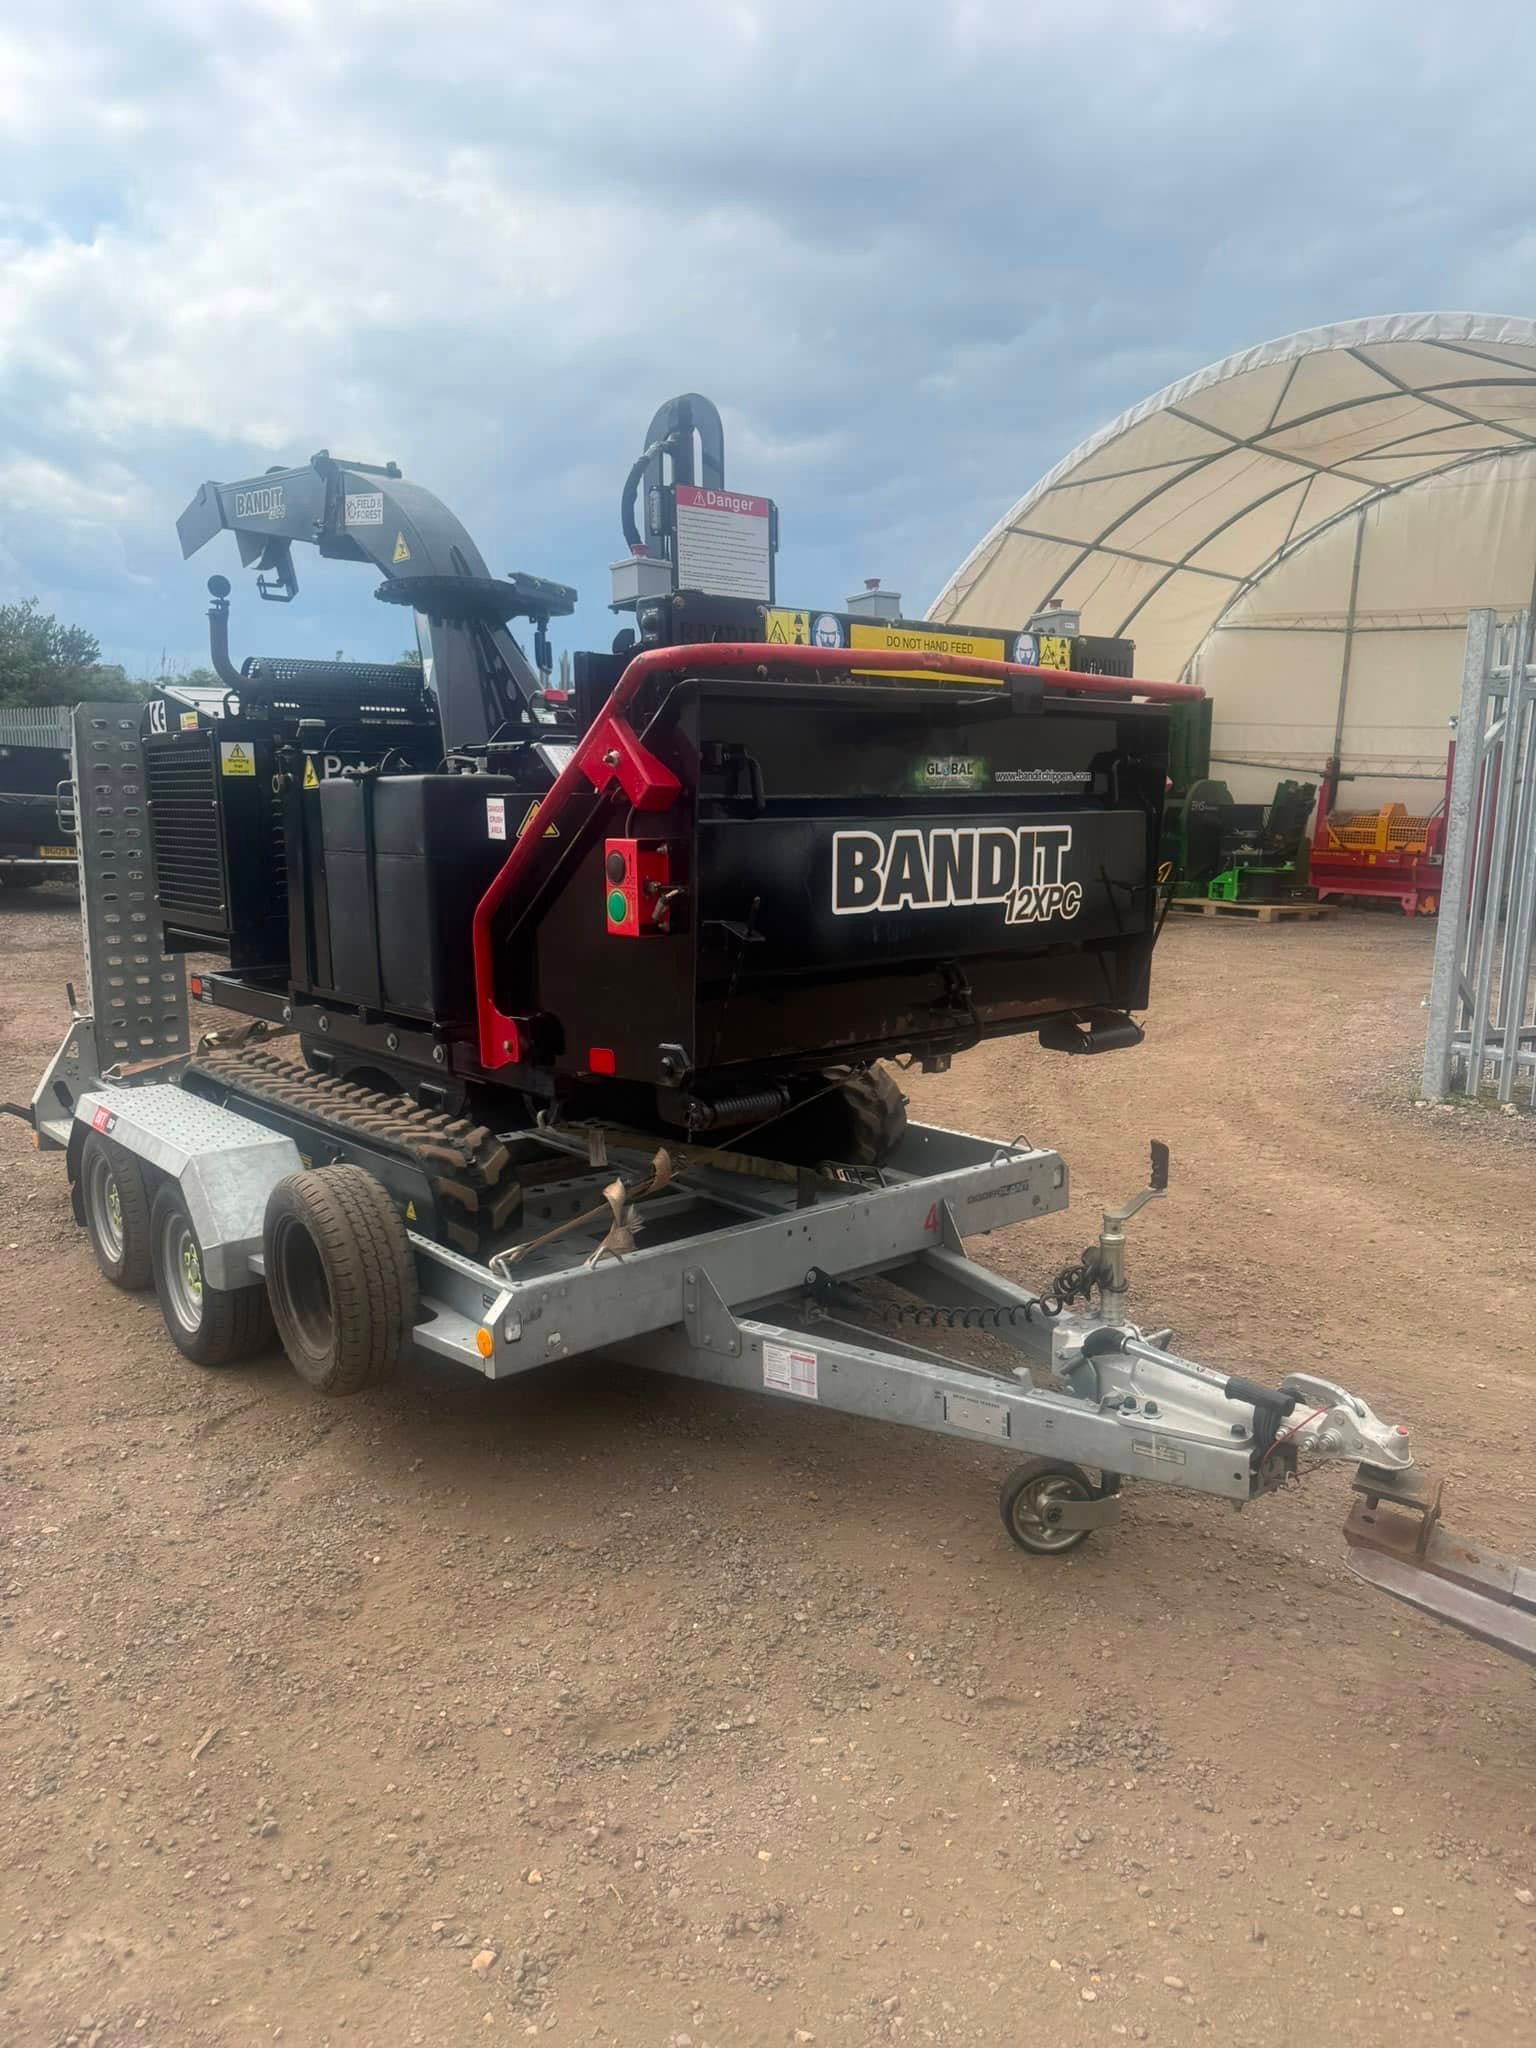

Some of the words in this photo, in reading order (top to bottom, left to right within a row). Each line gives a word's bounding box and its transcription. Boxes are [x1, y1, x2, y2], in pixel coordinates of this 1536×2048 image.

[236, 486, 283, 518] BANDIT
[357, 498, 377, 509] FIELD
[707, 491, 754, 512] Danger
[357, 510, 382, 520] FOREST
[886, 635, 900, 648] DO
[902, 637, 922, 649] NOT
[924, 639, 949, 653] HAND
[951, 642, 974, 654] FEED
[995, 769, 1092, 784] www.banditchippers.com
[832, 825, 1072, 915] BANDIT
[1005, 882, 1082, 925] 12XPC
[923, 1200, 938, 1233] 4
